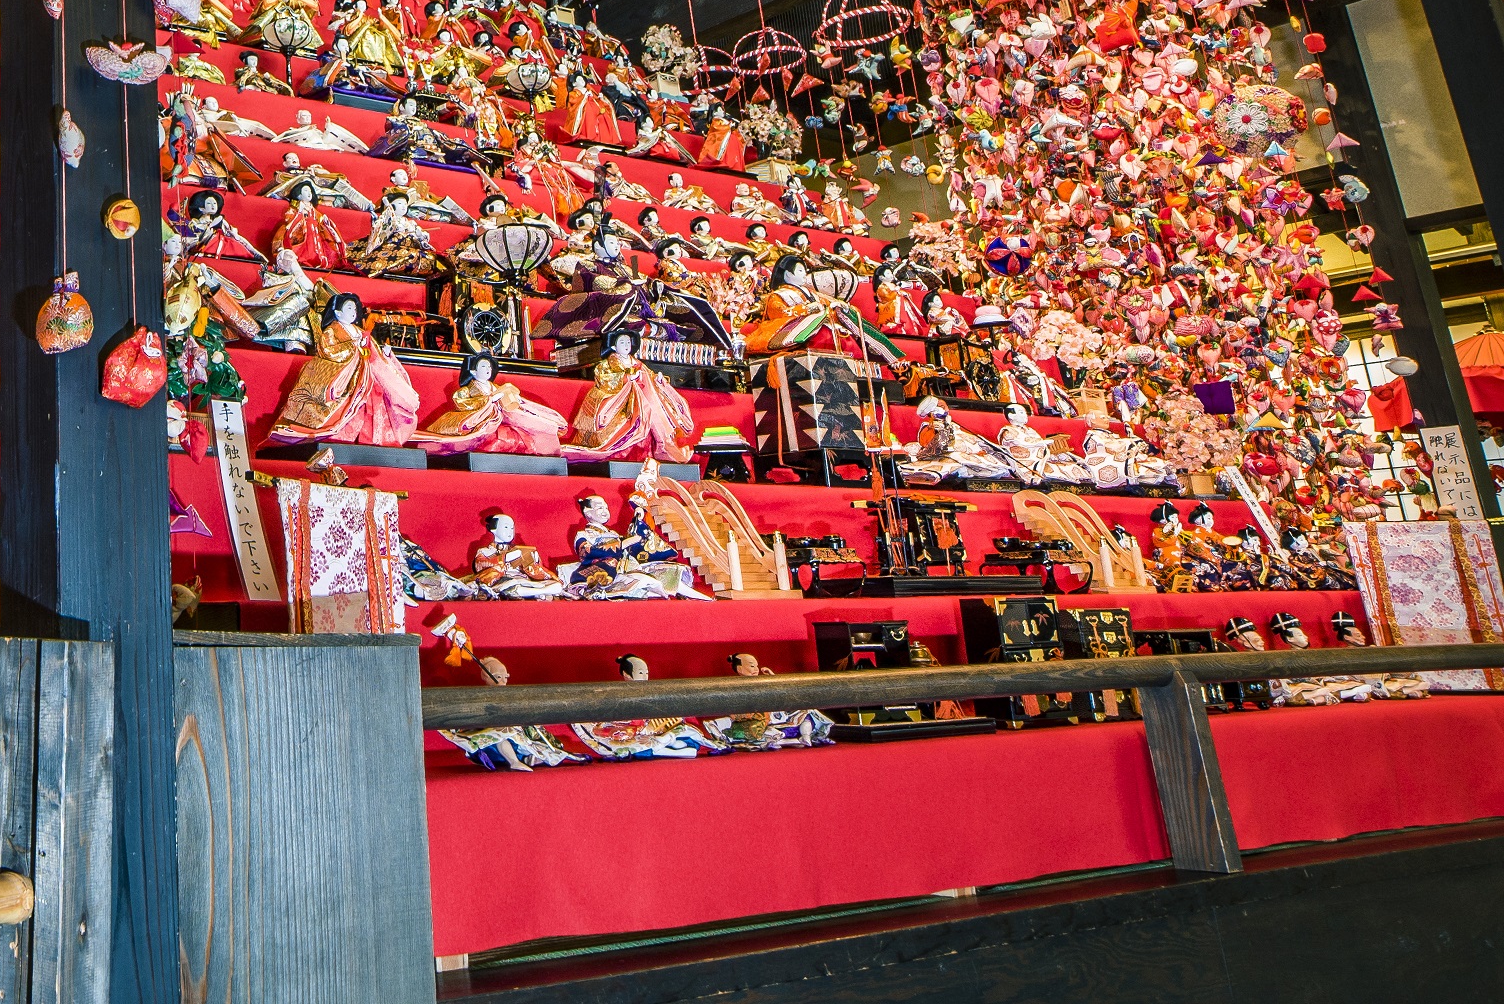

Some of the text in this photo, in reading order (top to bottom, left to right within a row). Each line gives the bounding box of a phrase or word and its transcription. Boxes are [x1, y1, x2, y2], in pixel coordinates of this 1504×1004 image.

[219, 403, 269, 593] 手を触れないで下さい
[1444, 432, 1477, 517] 展示品には
